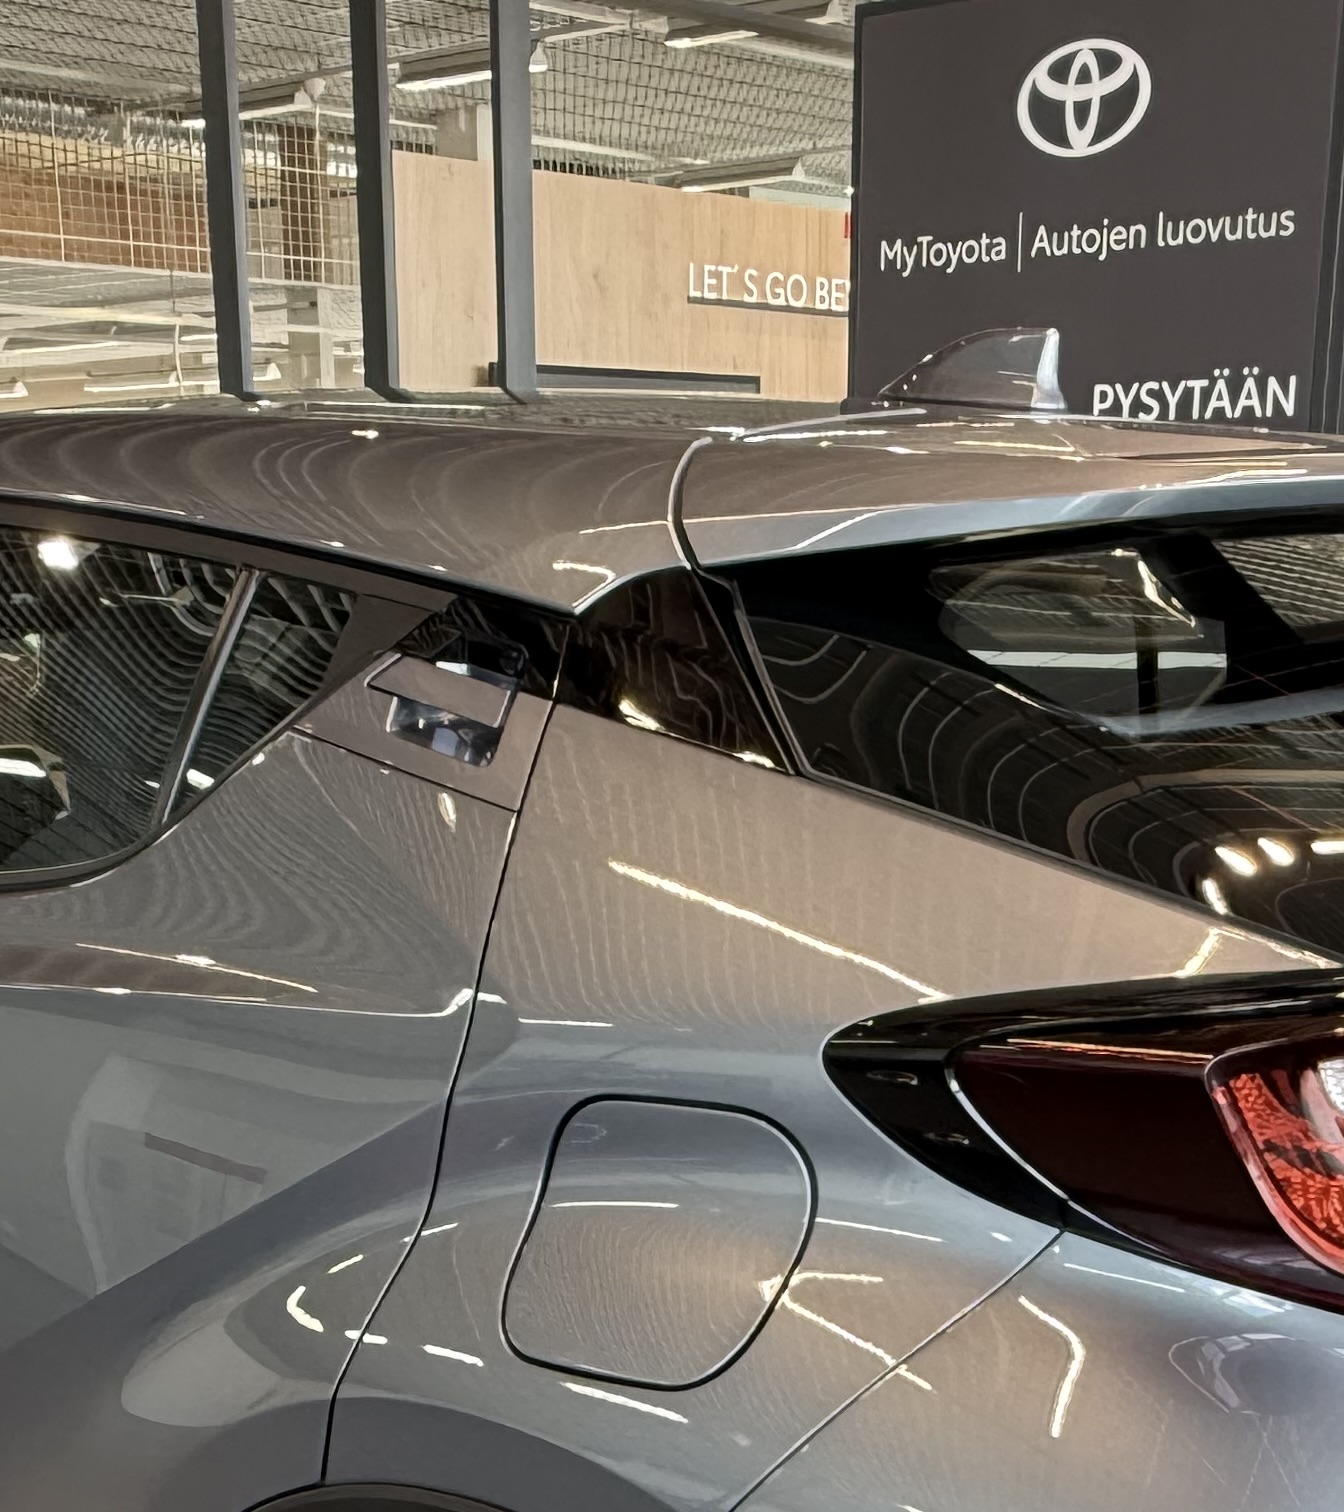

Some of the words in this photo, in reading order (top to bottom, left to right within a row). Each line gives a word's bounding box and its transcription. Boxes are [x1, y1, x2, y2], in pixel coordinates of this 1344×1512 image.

[880, 232, 1007, 278] MyToyota
[1030, 219, 1147, 261] Autojen
[1157, 207, 1295, 247] luovutus
[689, 262, 758, 303] LET'S
[765, 271, 807, 308] GO
[1093, 367, 1297, 420] PYSYTÄÄN
